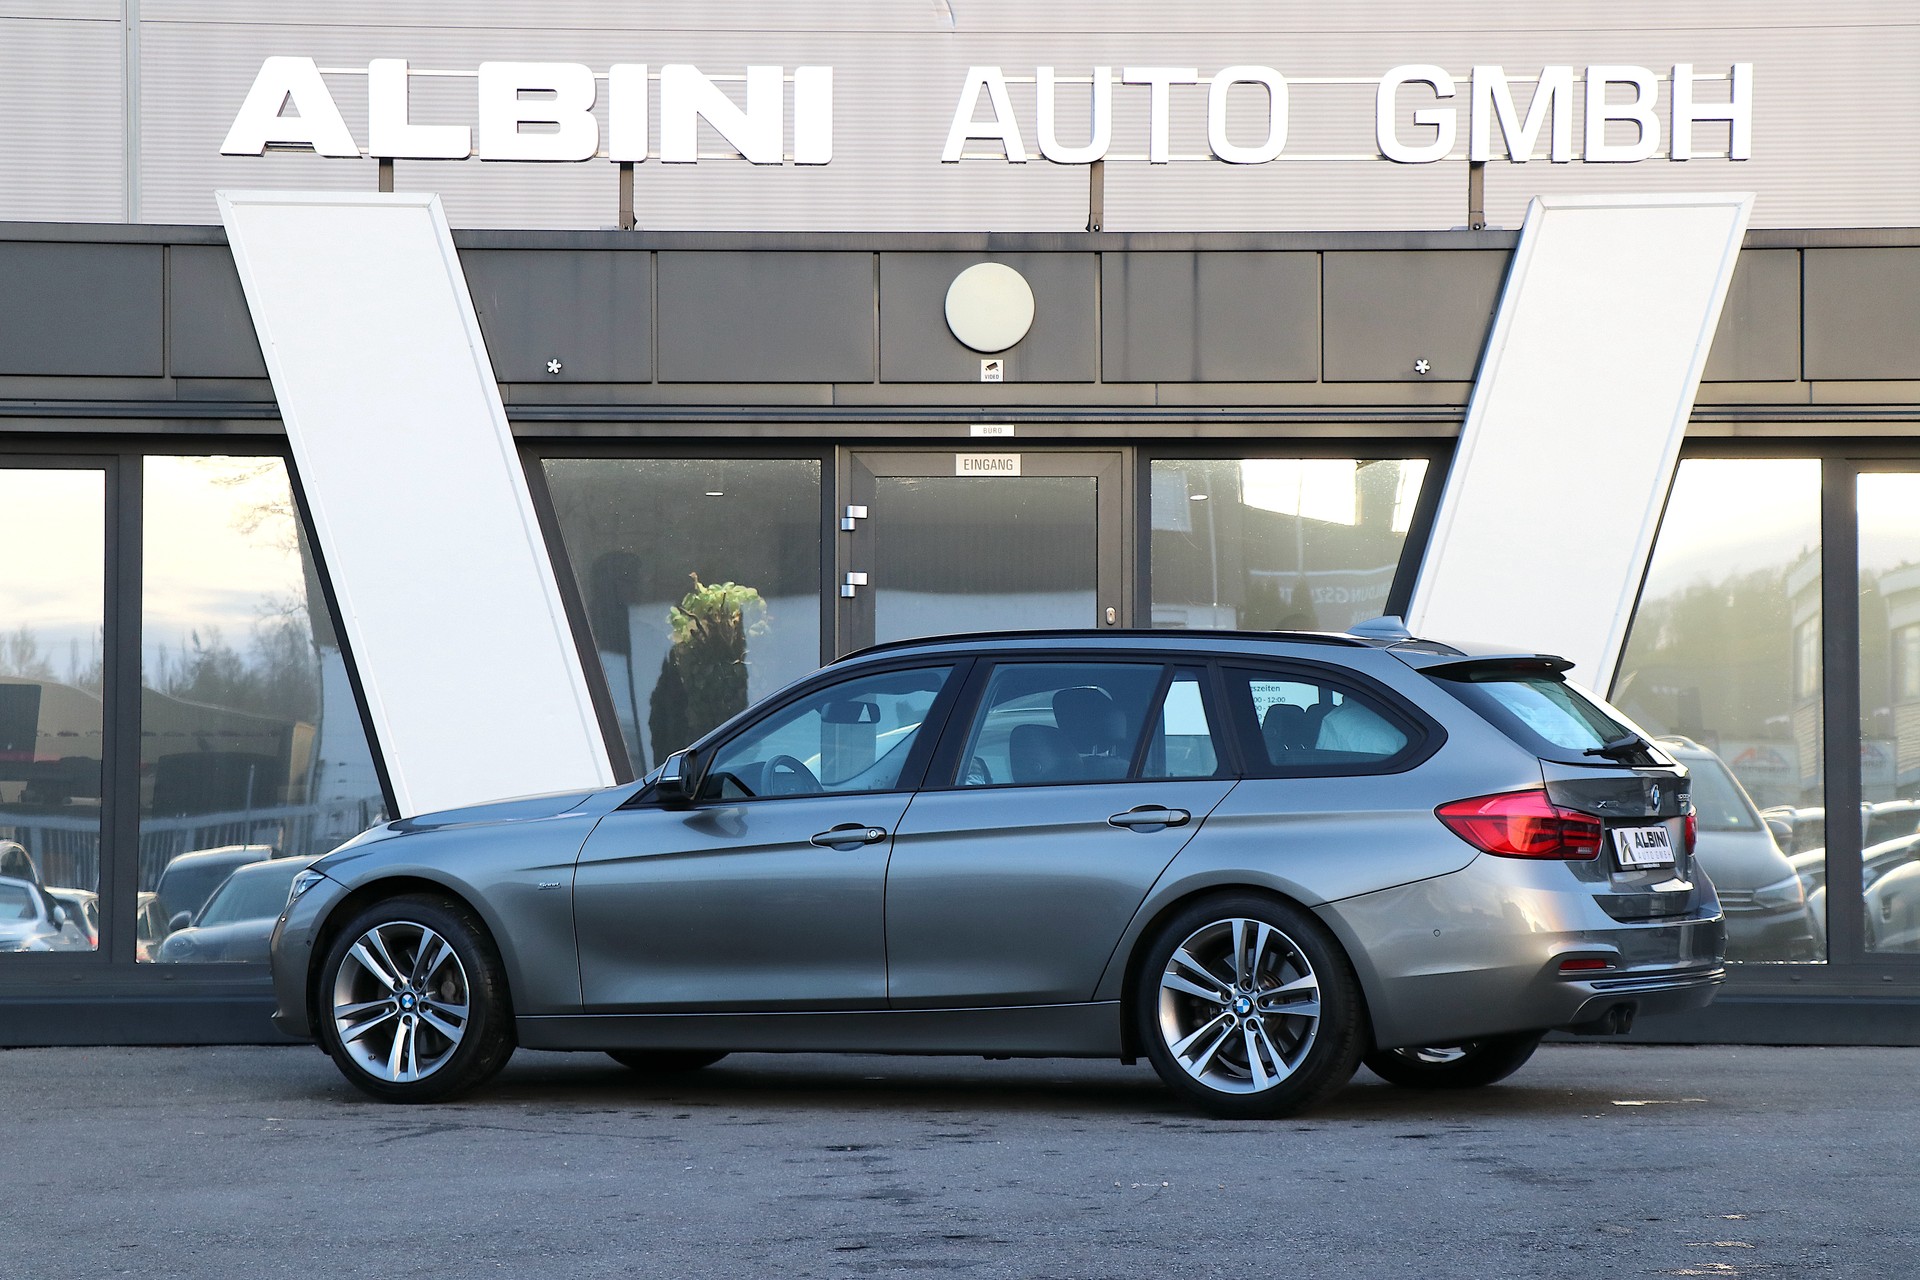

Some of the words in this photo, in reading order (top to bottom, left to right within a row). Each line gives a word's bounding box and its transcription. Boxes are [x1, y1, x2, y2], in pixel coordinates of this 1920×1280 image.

[219, 56, 834, 166] ALBINI
[941, 64, 1289, 164] AUTO
[1375, 62, 1754, 164] GMBH
[963, 458, 1014, 471] EINGANG
[1634, 831, 1669, 849] ALBINI
